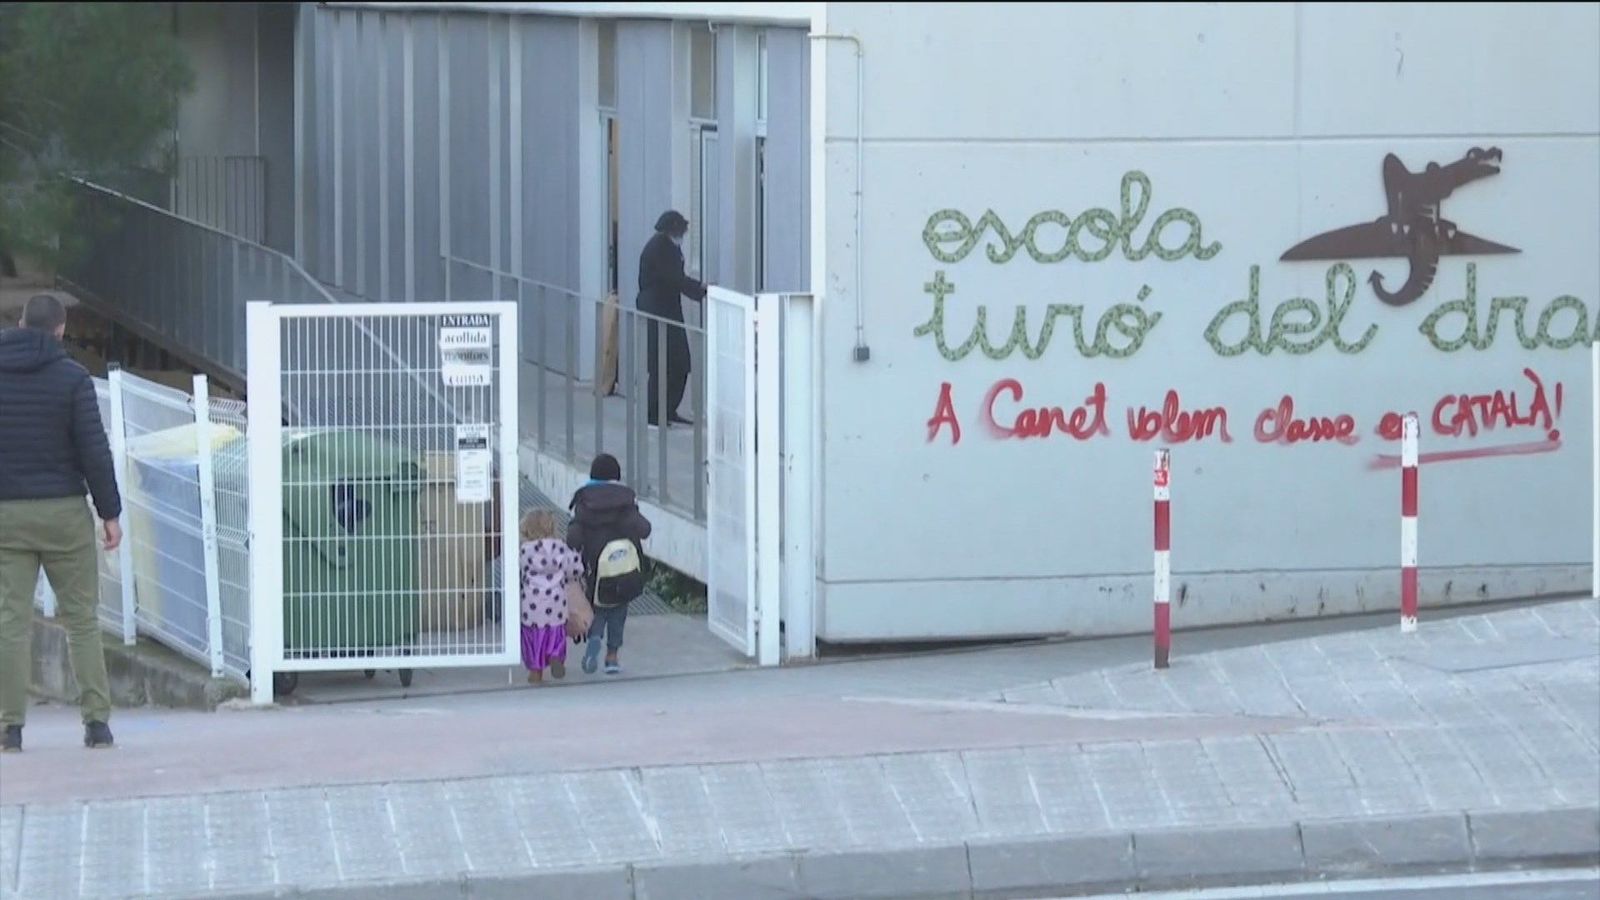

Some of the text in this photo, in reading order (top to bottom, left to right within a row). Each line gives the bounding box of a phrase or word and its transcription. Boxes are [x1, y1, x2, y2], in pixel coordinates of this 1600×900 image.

[922, 171, 1221, 264] escola
[442, 315, 489, 327] ENTRADA
[913, 262, 1600, 361] turó del dra
[444, 331, 487, 344] acollida
[444, 351, 489, 361] monitors
[926, 369, 1563, 446] A Canet volem classe e CATALÀ!
